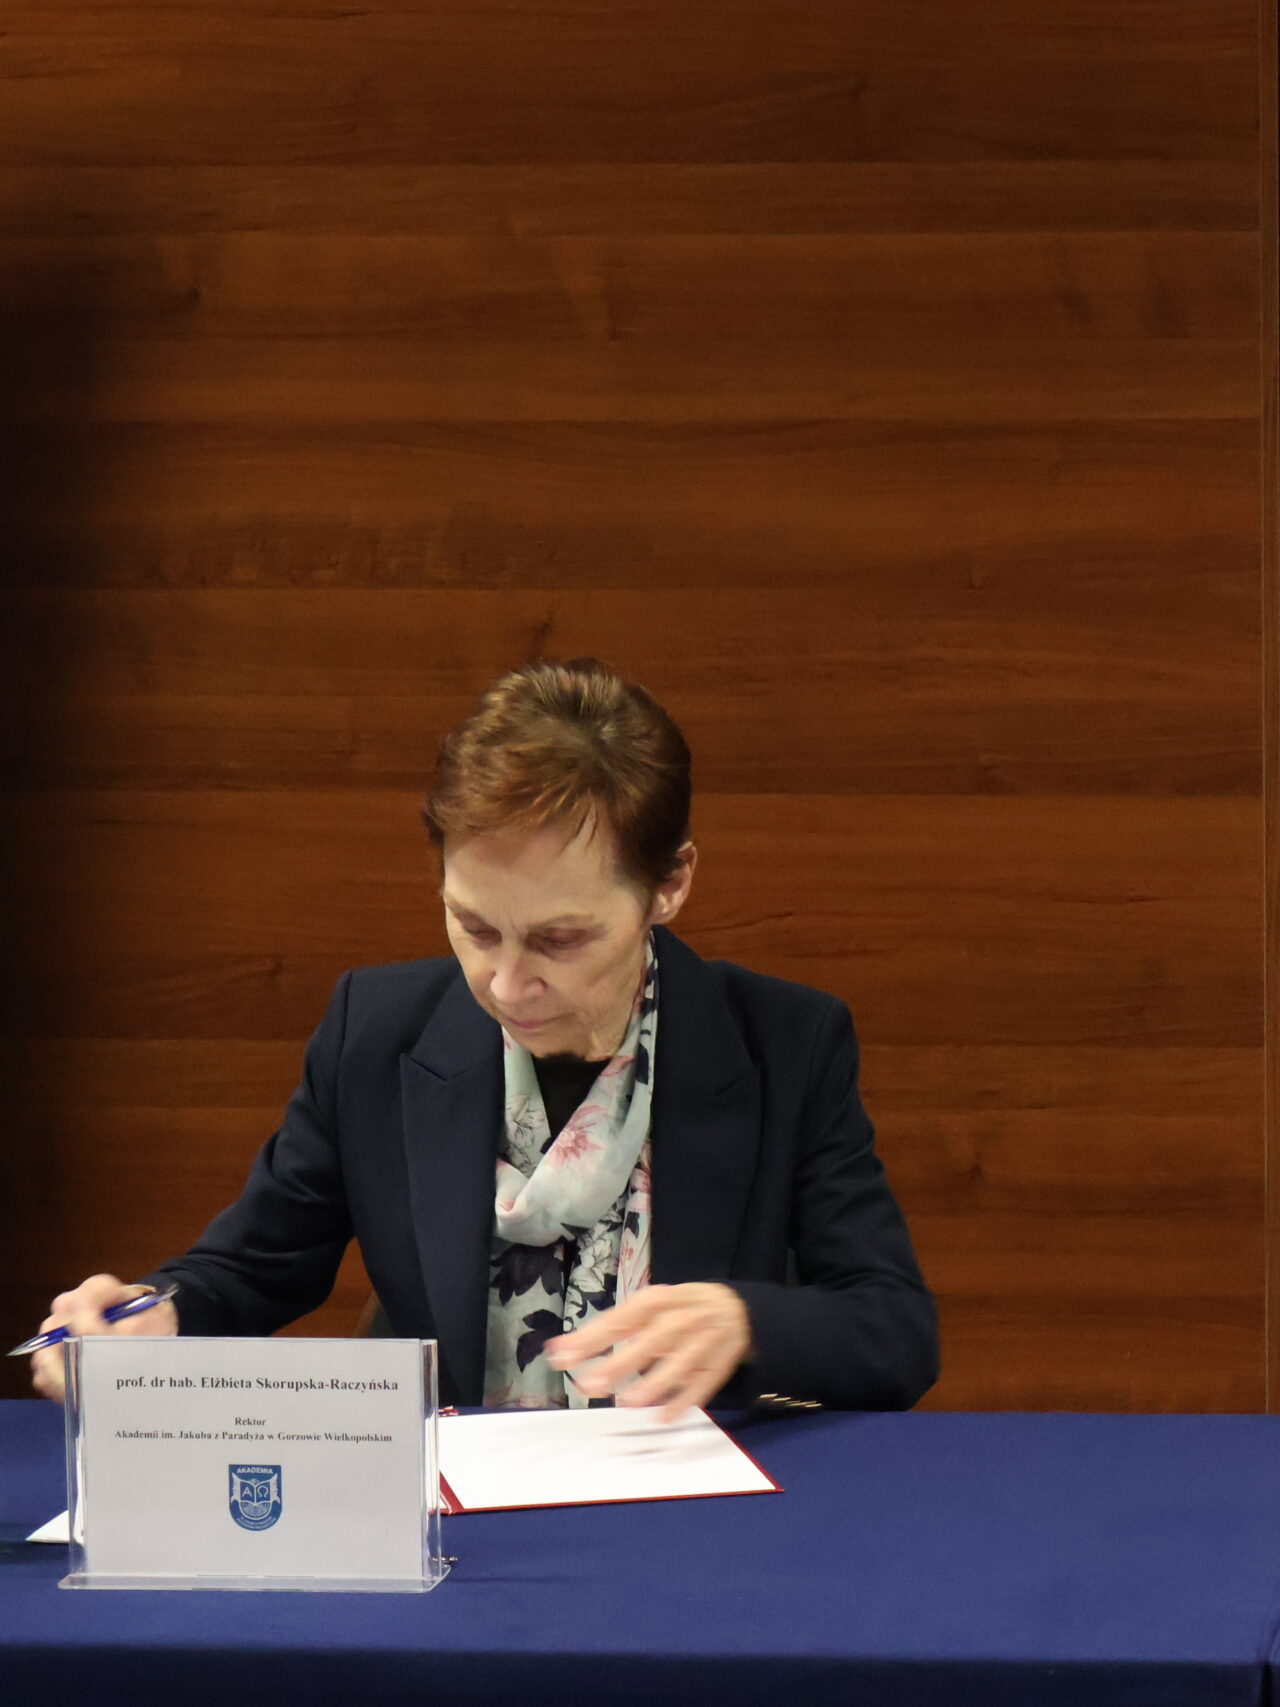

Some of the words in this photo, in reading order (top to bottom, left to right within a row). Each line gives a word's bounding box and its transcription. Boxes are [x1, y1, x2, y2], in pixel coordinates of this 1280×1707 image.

[116, 1376, 147, 1390] prof.
[150, 1376, 166, 1388] dr
[169, 1377, 197, 1388] hab.
[201, 1376, 252, 1389] Elżbieta
[256, 1377, 398, 1393] Skorupska-Raczyńska
[234, 1417, 266, 1426] Rektor
[115, 1430, 159, 1439] Akademii
[161, 1430, 175, 1439] im.
[178, 1430, 212, 1440] Jakuba
[214, 1432, 219, 1440] z
[221, 1431, 264, 1442] Paradyża
[267, 1433, 275, 1441] w
[277, 1432, 321, 1441] Gorzowie
[324, 1432, 392, 1443] Wielkopolskim
[236, 1467, 274, 1475] AKADEMIA
